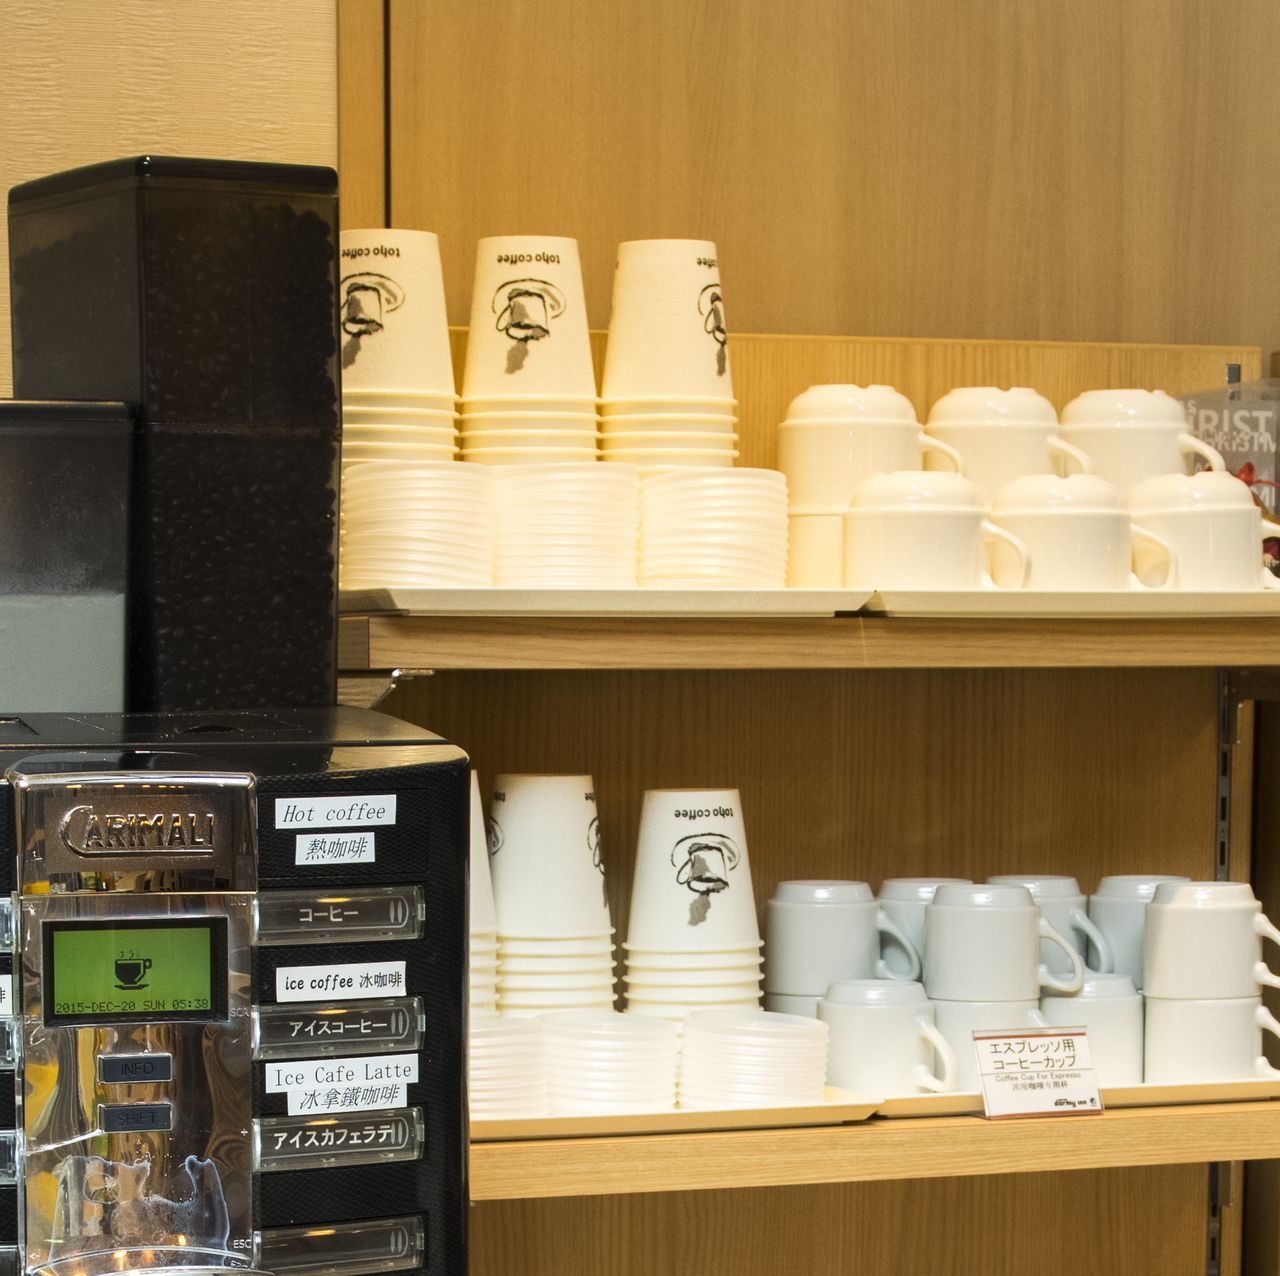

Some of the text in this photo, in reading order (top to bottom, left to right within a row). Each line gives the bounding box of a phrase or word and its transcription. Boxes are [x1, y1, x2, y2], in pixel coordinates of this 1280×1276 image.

[496, 253, 533, 266] coffee
[283, 802, 386, 823] Hot coffee
[673, 808, 711, 820] coffee
[60, 804, 214, 858] CARIMALI
[305, 837, 368, 861] 熱咖啡
[299, 905, 359, 922] コーヒー
[285, 971, 403, 992] ice coffee 冰咖啡
[55, 998, 209, 1013] 2015-DEC-20 SUN 05:38
[289, 1018, 387, 1037] アイスコーヒー
[990, 1038, 1076, 1054] エスプレッソ用
[120, 1062, 155, 1076] INFO
[993, 1053, 1076, 1070] コーヒーカップ
[275, 1063, 412, 1087] Ice Cafe Latte
[299, 1083, 400, 1110] 冰拿鐵咖啡
[116, 1111, 158, 1127] SHIFT
[273, 1124, 393, 1150] アイスカフェラテ
[233, 1239, 252, 1249] ESC
